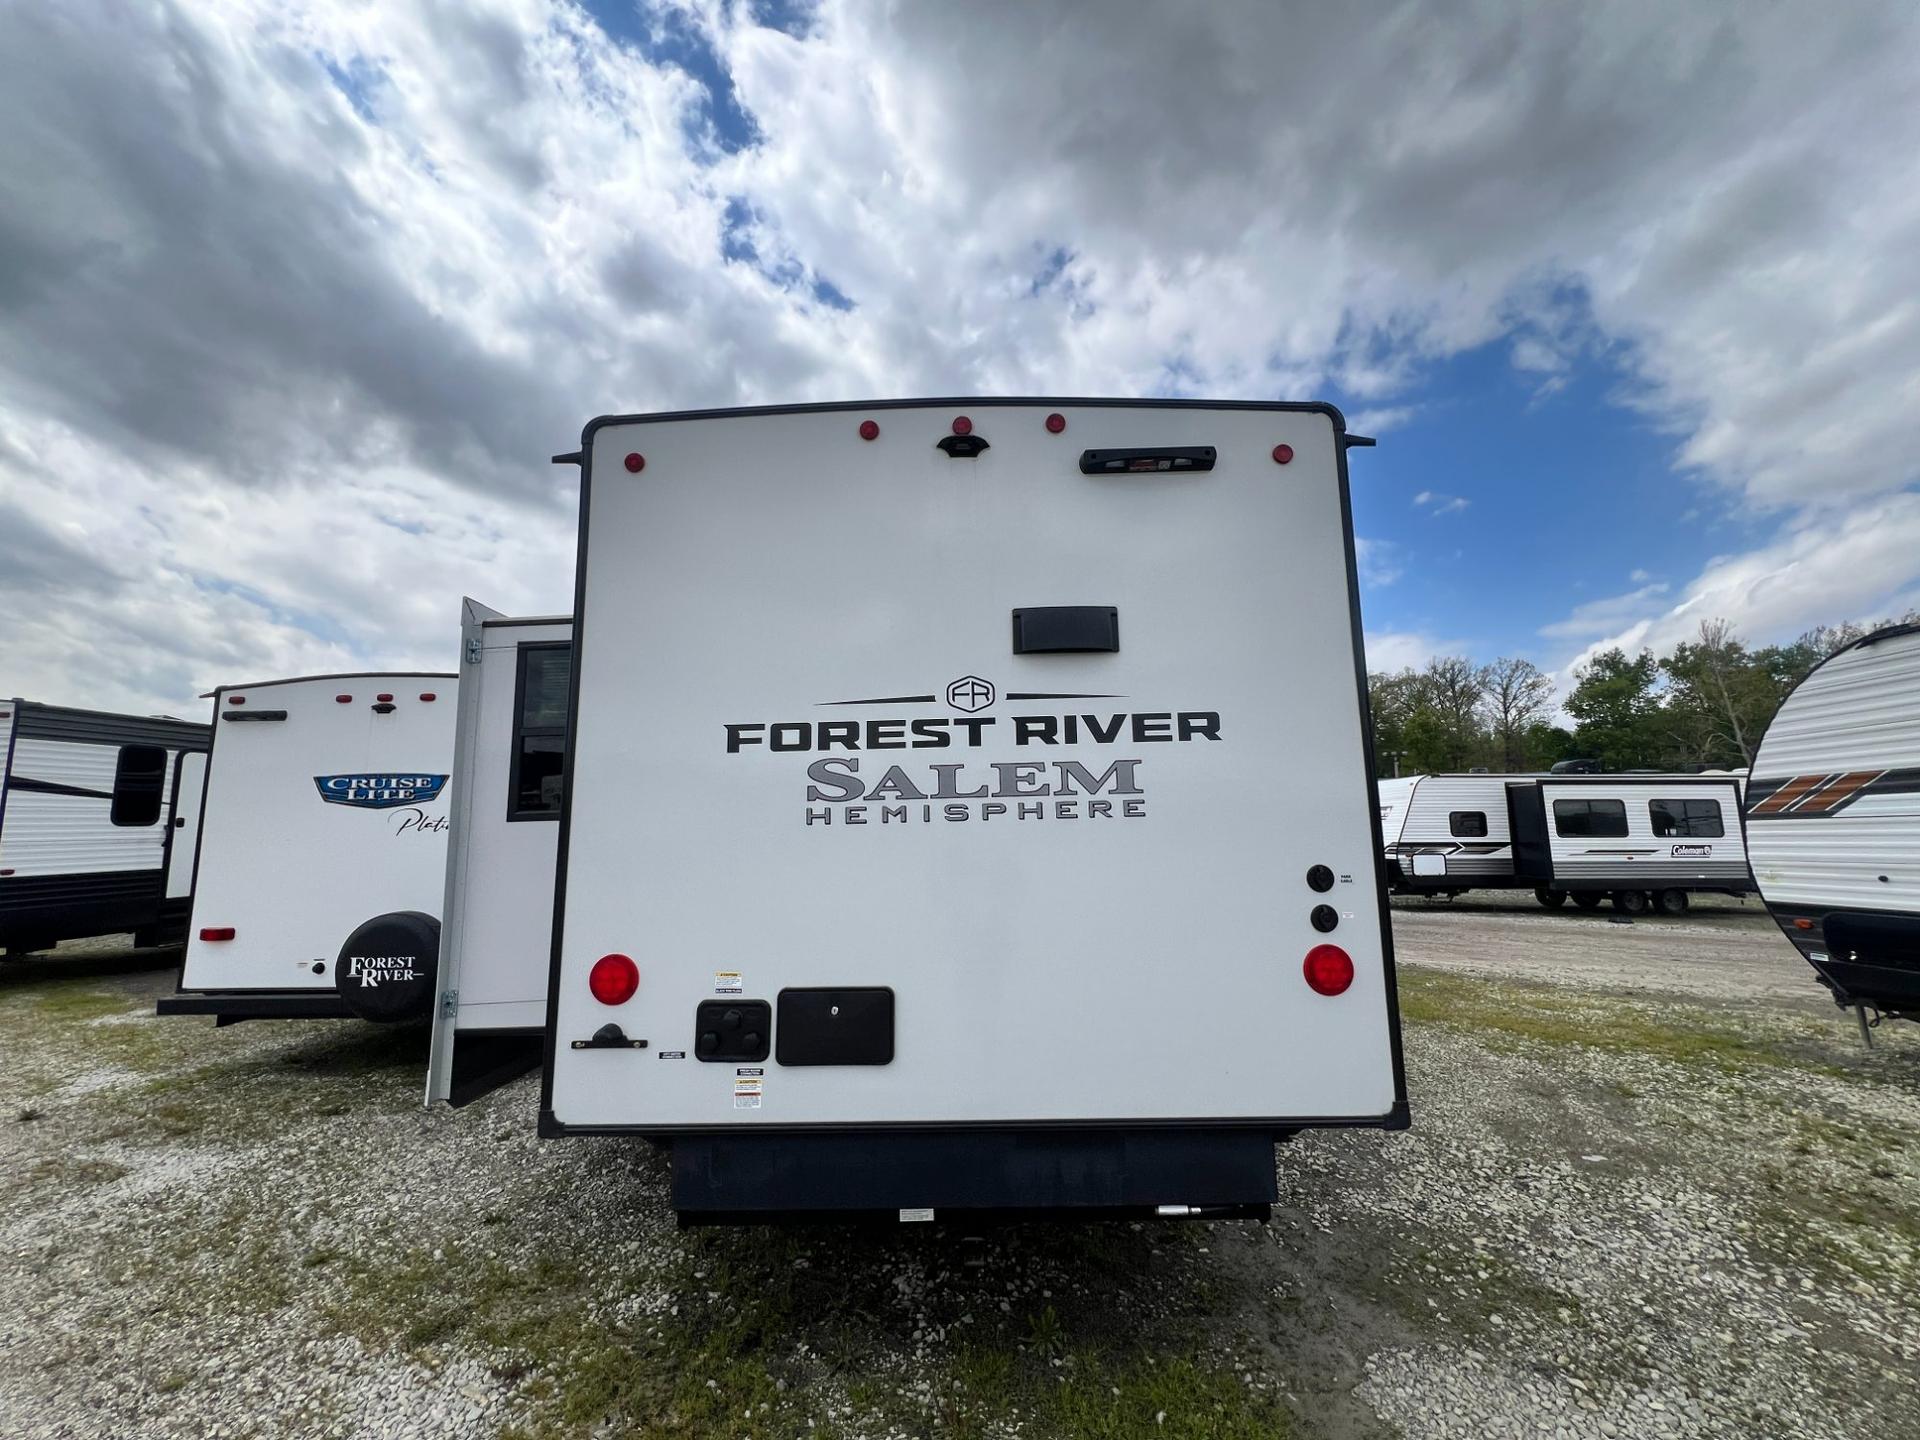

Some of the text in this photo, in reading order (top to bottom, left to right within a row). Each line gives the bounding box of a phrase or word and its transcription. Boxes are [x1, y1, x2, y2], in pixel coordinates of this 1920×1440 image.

[723, 711, 1224, 754] FOREST RIVER
[327, 777, 432, 789] CRUISE
[806, 757, 1145, 803] SALEM
[346, 788, 416, 800] LITE
[806, 799, 1147, 826] HEMISPHERE
[1673, 845, 1704, 856] Coleman
[349, 956, 416, 975] FOREST
[360, 968, 414, 987] RIVER
